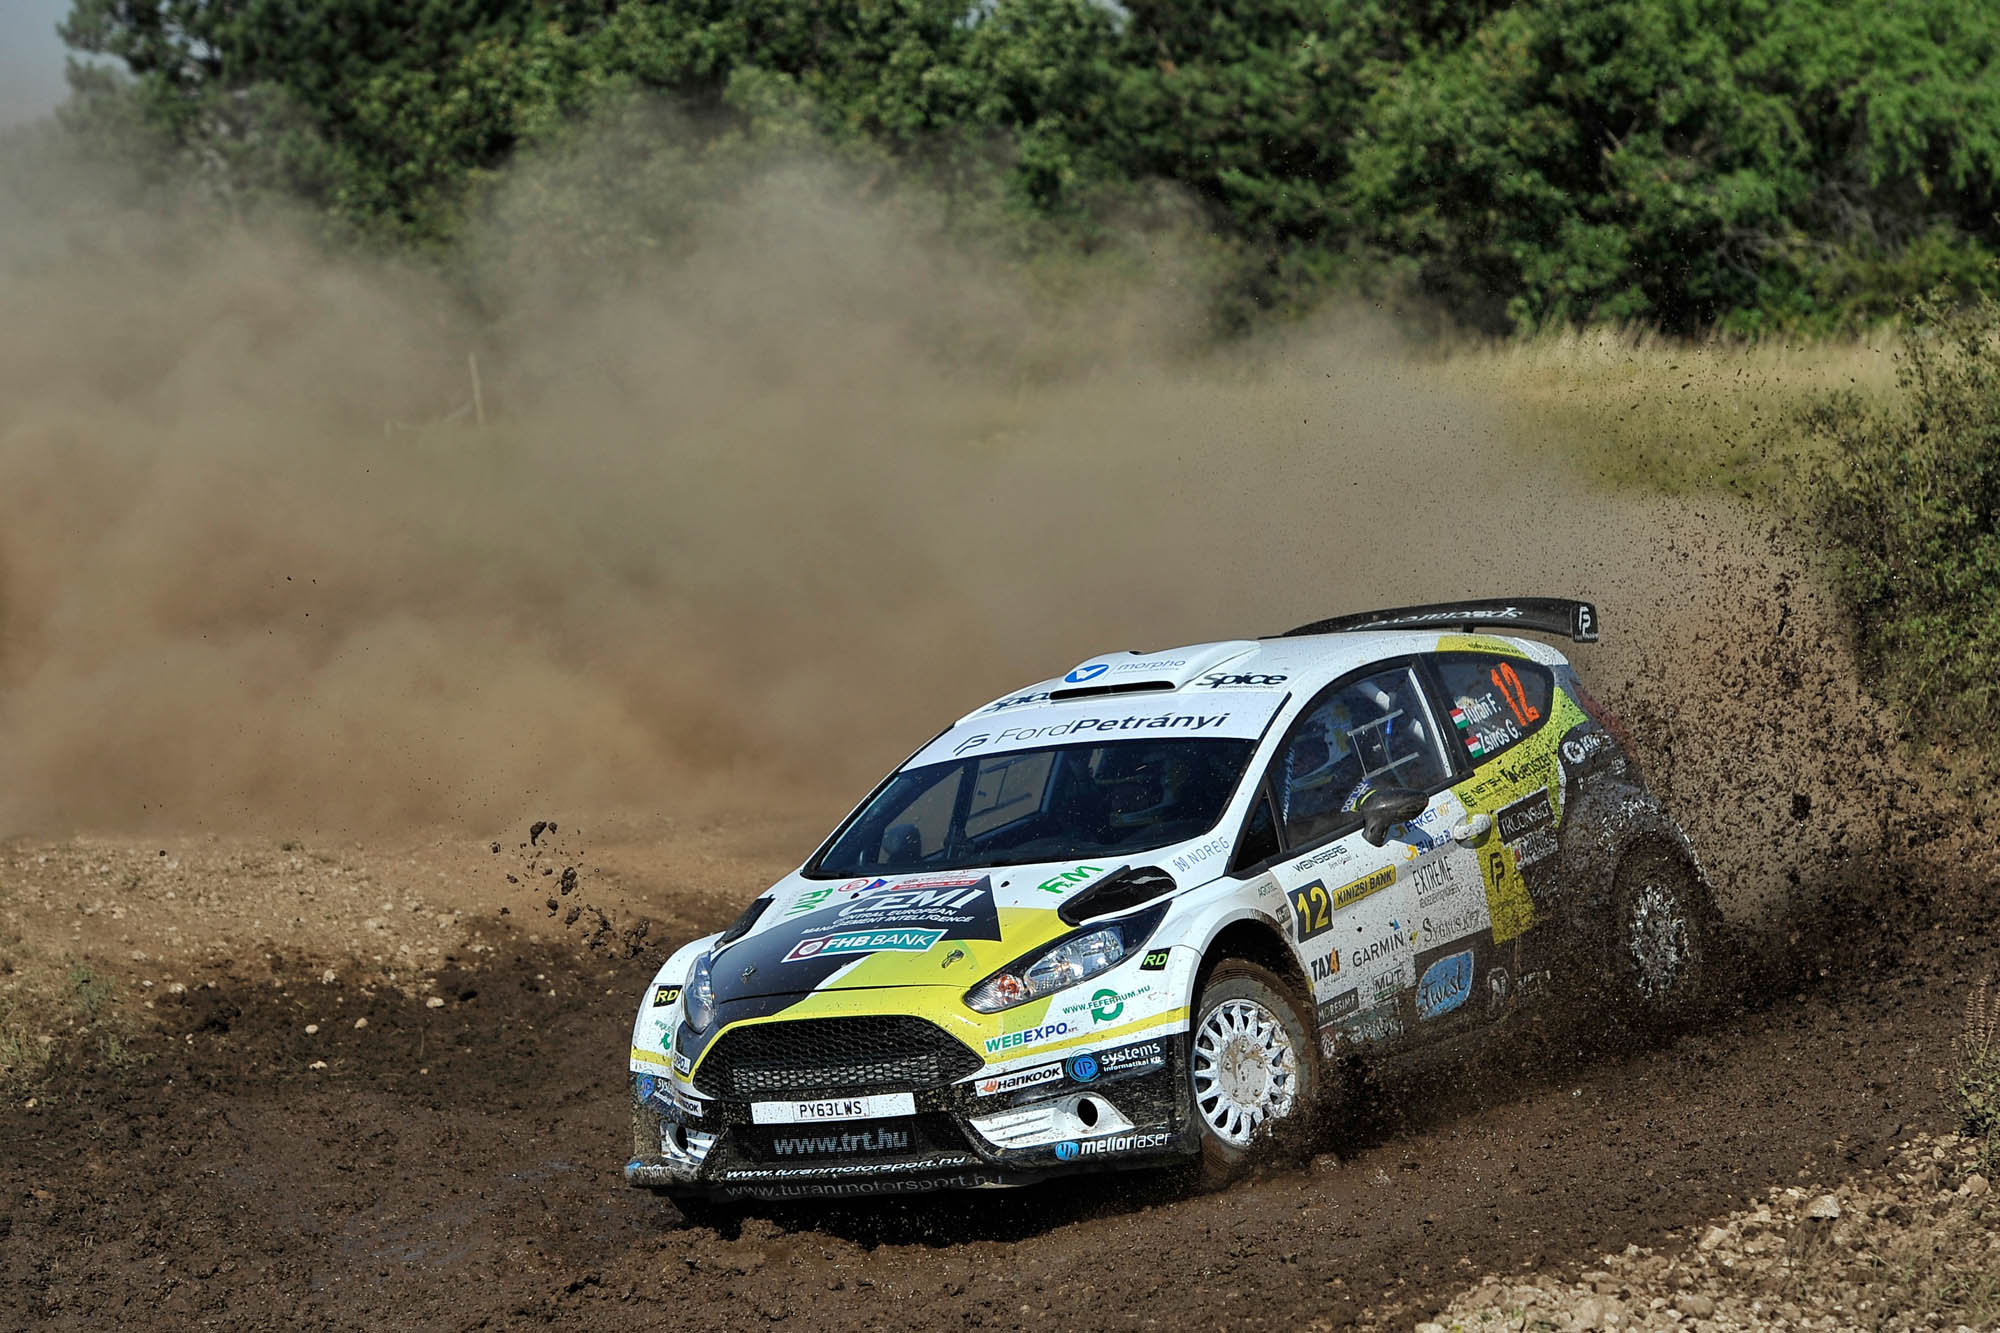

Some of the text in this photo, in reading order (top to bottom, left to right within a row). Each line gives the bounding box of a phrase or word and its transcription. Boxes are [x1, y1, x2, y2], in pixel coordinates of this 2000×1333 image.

[1117, 658, 1187, 672] morpho
[1195, 672, 1288, 688] Spice
[1490, 662, 1540, 727] 12
[1187, 836, 1230, 864] NOREG
[1337, 870, 1394, 905] KINIZSI BANK
[1412, 856, 1454, 895] EXTREME
[839, 888, 987, 916] CEMI
[886, 907, 958, 917] EUROPEAN
[1297, 886, 1329, 933] 12
[884, 914, 976, 924] INTELLIGENCE
[821, 933, 928, 950] FHB BANK
[1352, 931, 1404, 967] GARMIN
[1143, 953, 1167, 967] RD
[656, 989, 680, 1002] RD
[985, 1022, 1068, 1052] WEBEXPO
[1101, 1042, 1161, 1066] systems
[799, 1101, 863, 1117] PY63LWS
[773, 1128, 909, 1155] www.trt.hu
[726, 1155, 966, 1178] www.turanmotorsport.hu
